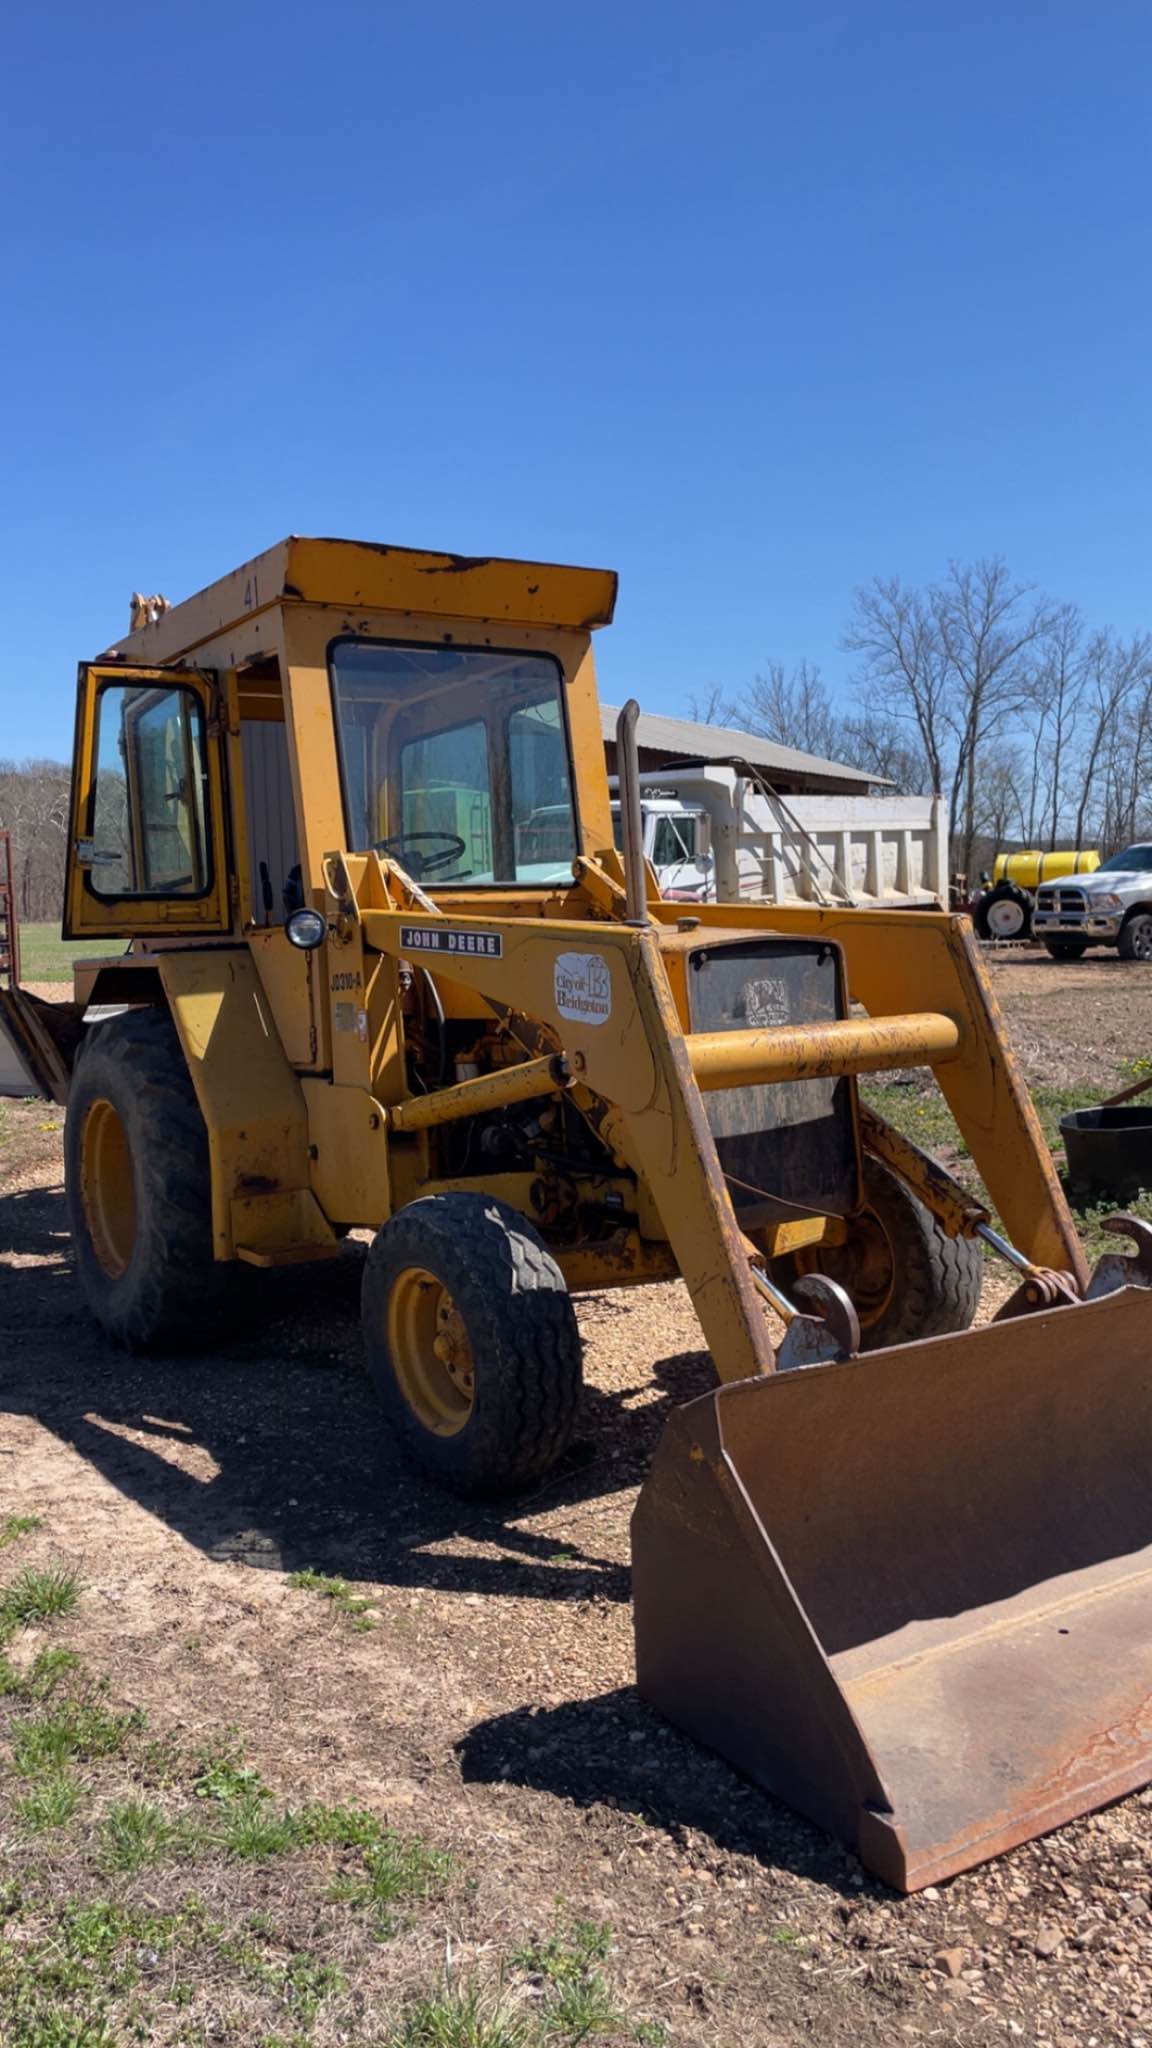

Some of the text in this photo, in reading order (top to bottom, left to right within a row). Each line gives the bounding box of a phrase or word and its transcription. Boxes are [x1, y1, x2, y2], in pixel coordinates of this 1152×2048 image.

[407, 930, 496, 954] JOHN DEERE
[556, 975, 573, 992] City
